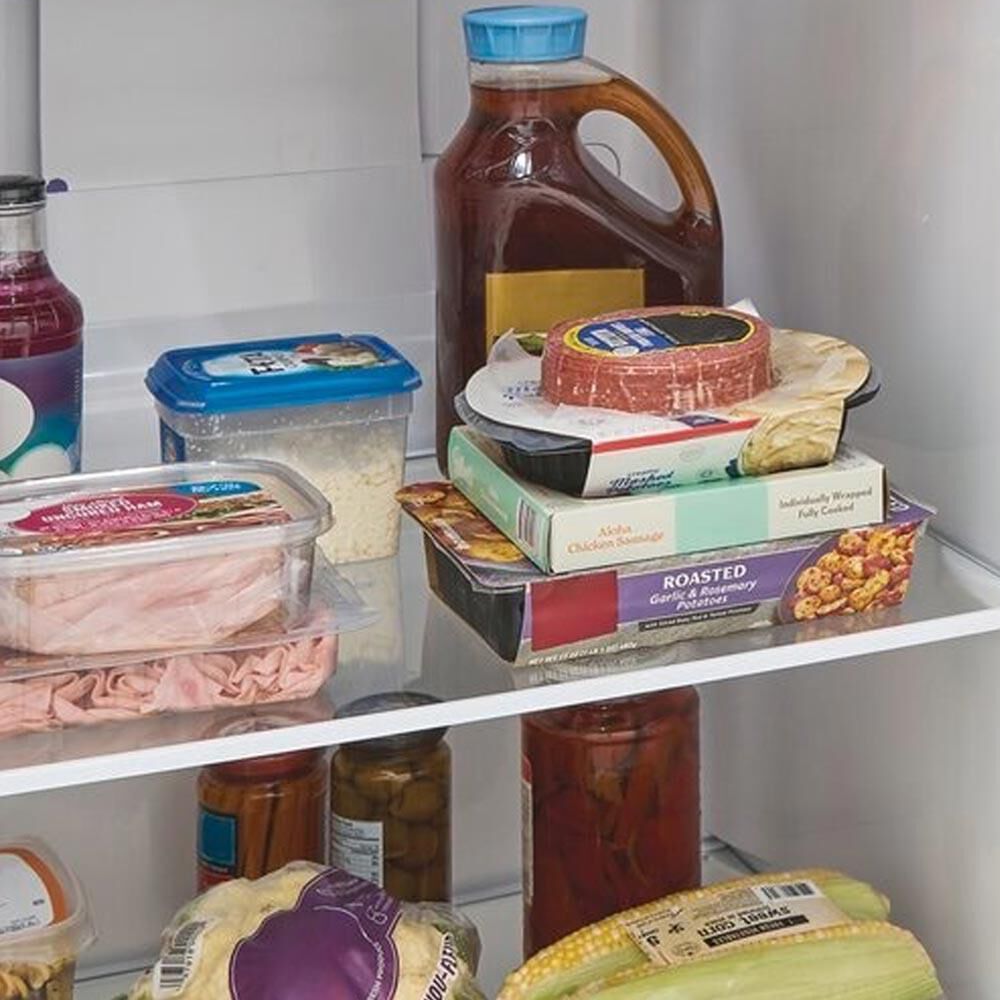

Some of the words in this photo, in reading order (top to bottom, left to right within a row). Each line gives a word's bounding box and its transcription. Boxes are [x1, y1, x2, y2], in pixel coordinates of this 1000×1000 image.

[779, 492, 830, 510] Individually
[831, 486, 873, 505] Wrapped
[797, 507, 820, 521] Fully
[821, 501, 855, 516] Cooked
[598, 523, 633, 539] Aloha
[566, 536, 615, 555] Chicken
[616, 530, 665, 549] Sausage
[662, 563, 748, 591] ROASTED
[649, 590, 686, 606] Garlic
[687, 588, 698, 599] &
[699, 578, 758, 600] Rosemary
[676, 595, 729, 612] Potatoes
[741, 905, 791, 926] sweet
[697, 920, 736, 938] corn
